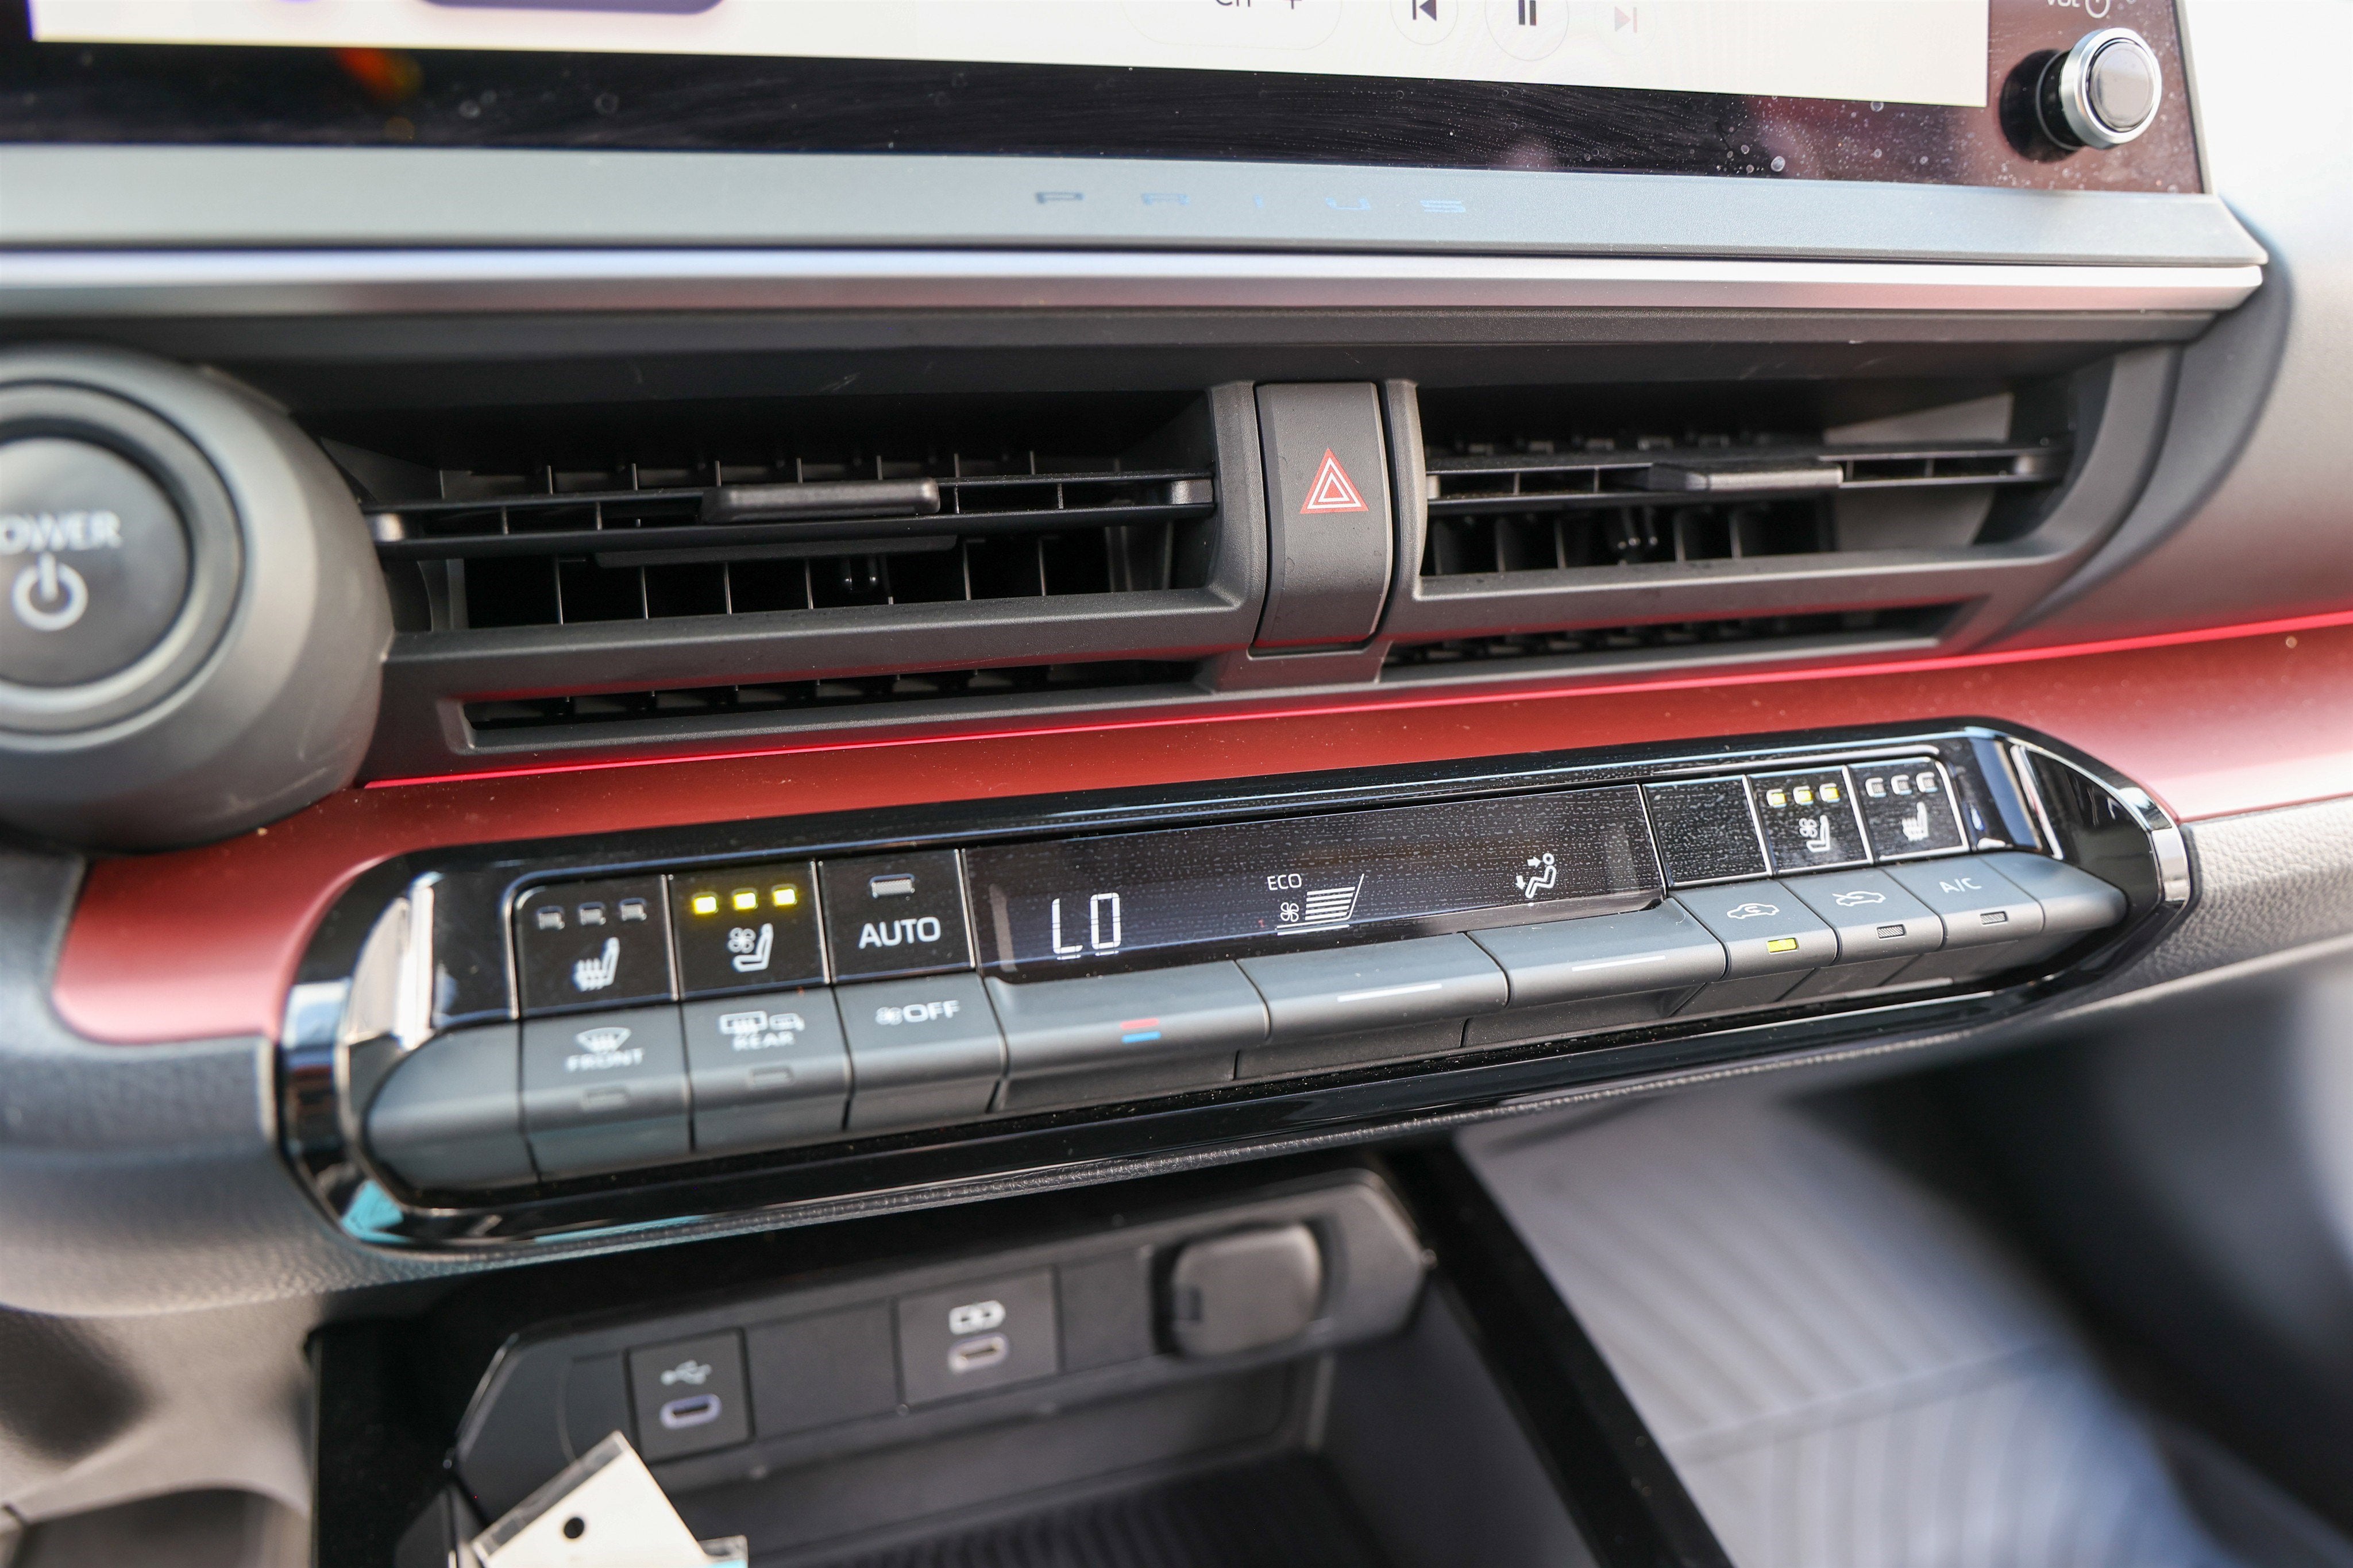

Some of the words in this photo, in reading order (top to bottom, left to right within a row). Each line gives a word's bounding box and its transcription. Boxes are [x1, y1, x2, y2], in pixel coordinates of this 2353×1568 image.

[1267, 873, 1302, 890] ECO
[1939, 878, 1982, 893] A/C
[858, 916, 941, 949] AUTO
[903, 1000, 960, 1022] OFF
[732, 1030, 794, 1051] REAR
[566, 1048, 644, 1073] FRONT
